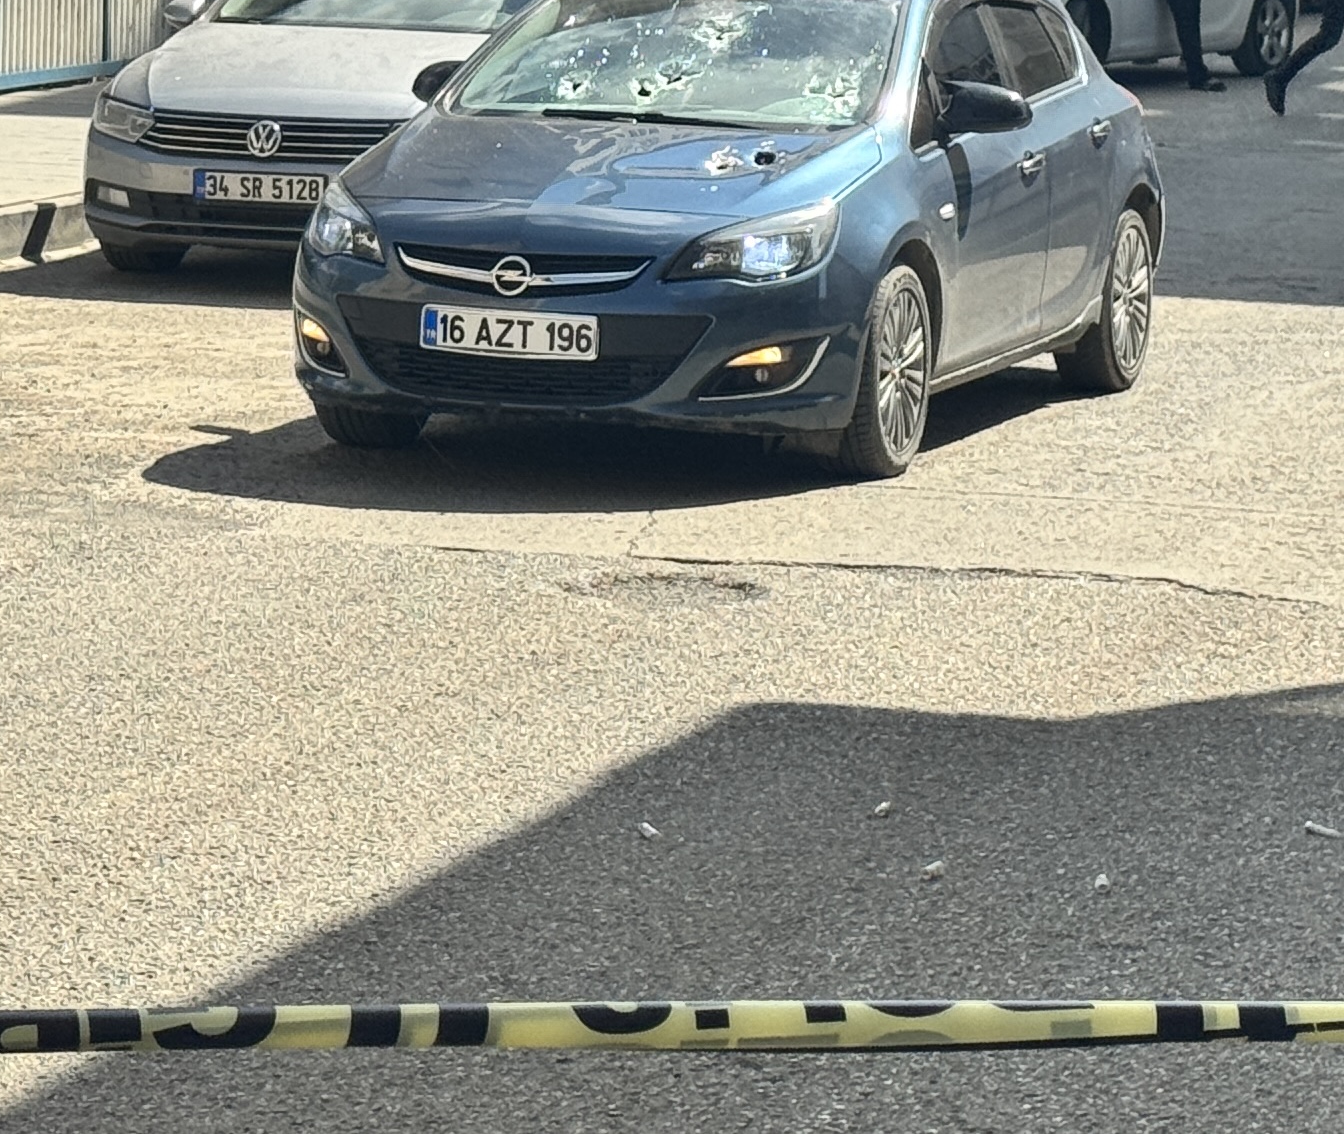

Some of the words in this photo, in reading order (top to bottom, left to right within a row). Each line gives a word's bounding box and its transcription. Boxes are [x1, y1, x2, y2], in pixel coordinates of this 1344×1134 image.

[206, 174, 230, 198] 34
[239, 176, 264, 199] SR
[271, 177, 320, 202] 5128
[440, 313, 466, 344] 16
[474, 317, 535, 350] AZT
[545, 321, 593, 354] 196
